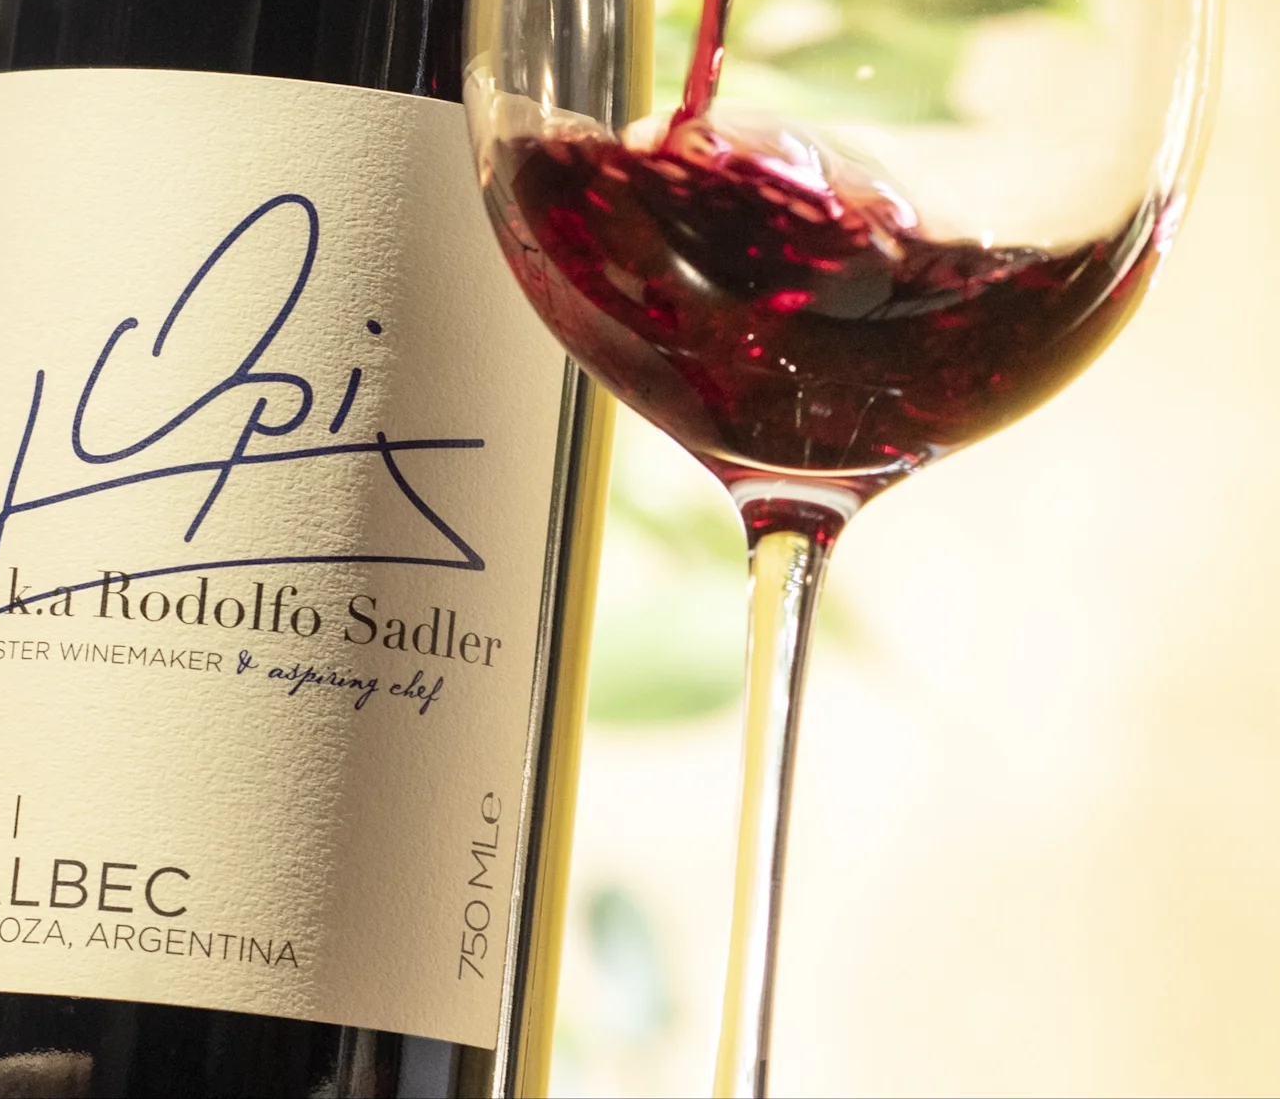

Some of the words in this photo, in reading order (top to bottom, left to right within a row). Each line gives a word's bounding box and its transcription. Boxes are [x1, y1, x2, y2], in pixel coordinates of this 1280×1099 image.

[92, 569, 321, 638] Rodolfo
[344, 594, 502, 668] Sadler
[60, 642, 223, 673] WINEMAKER
[236, 649, 259, 675] &
[268, 663, 380, 711] aspiring
[389, 670, 445, 716] chef
[85, 922, 300, 970] ARGENTINA
[458, 899, 491, 981] 750
